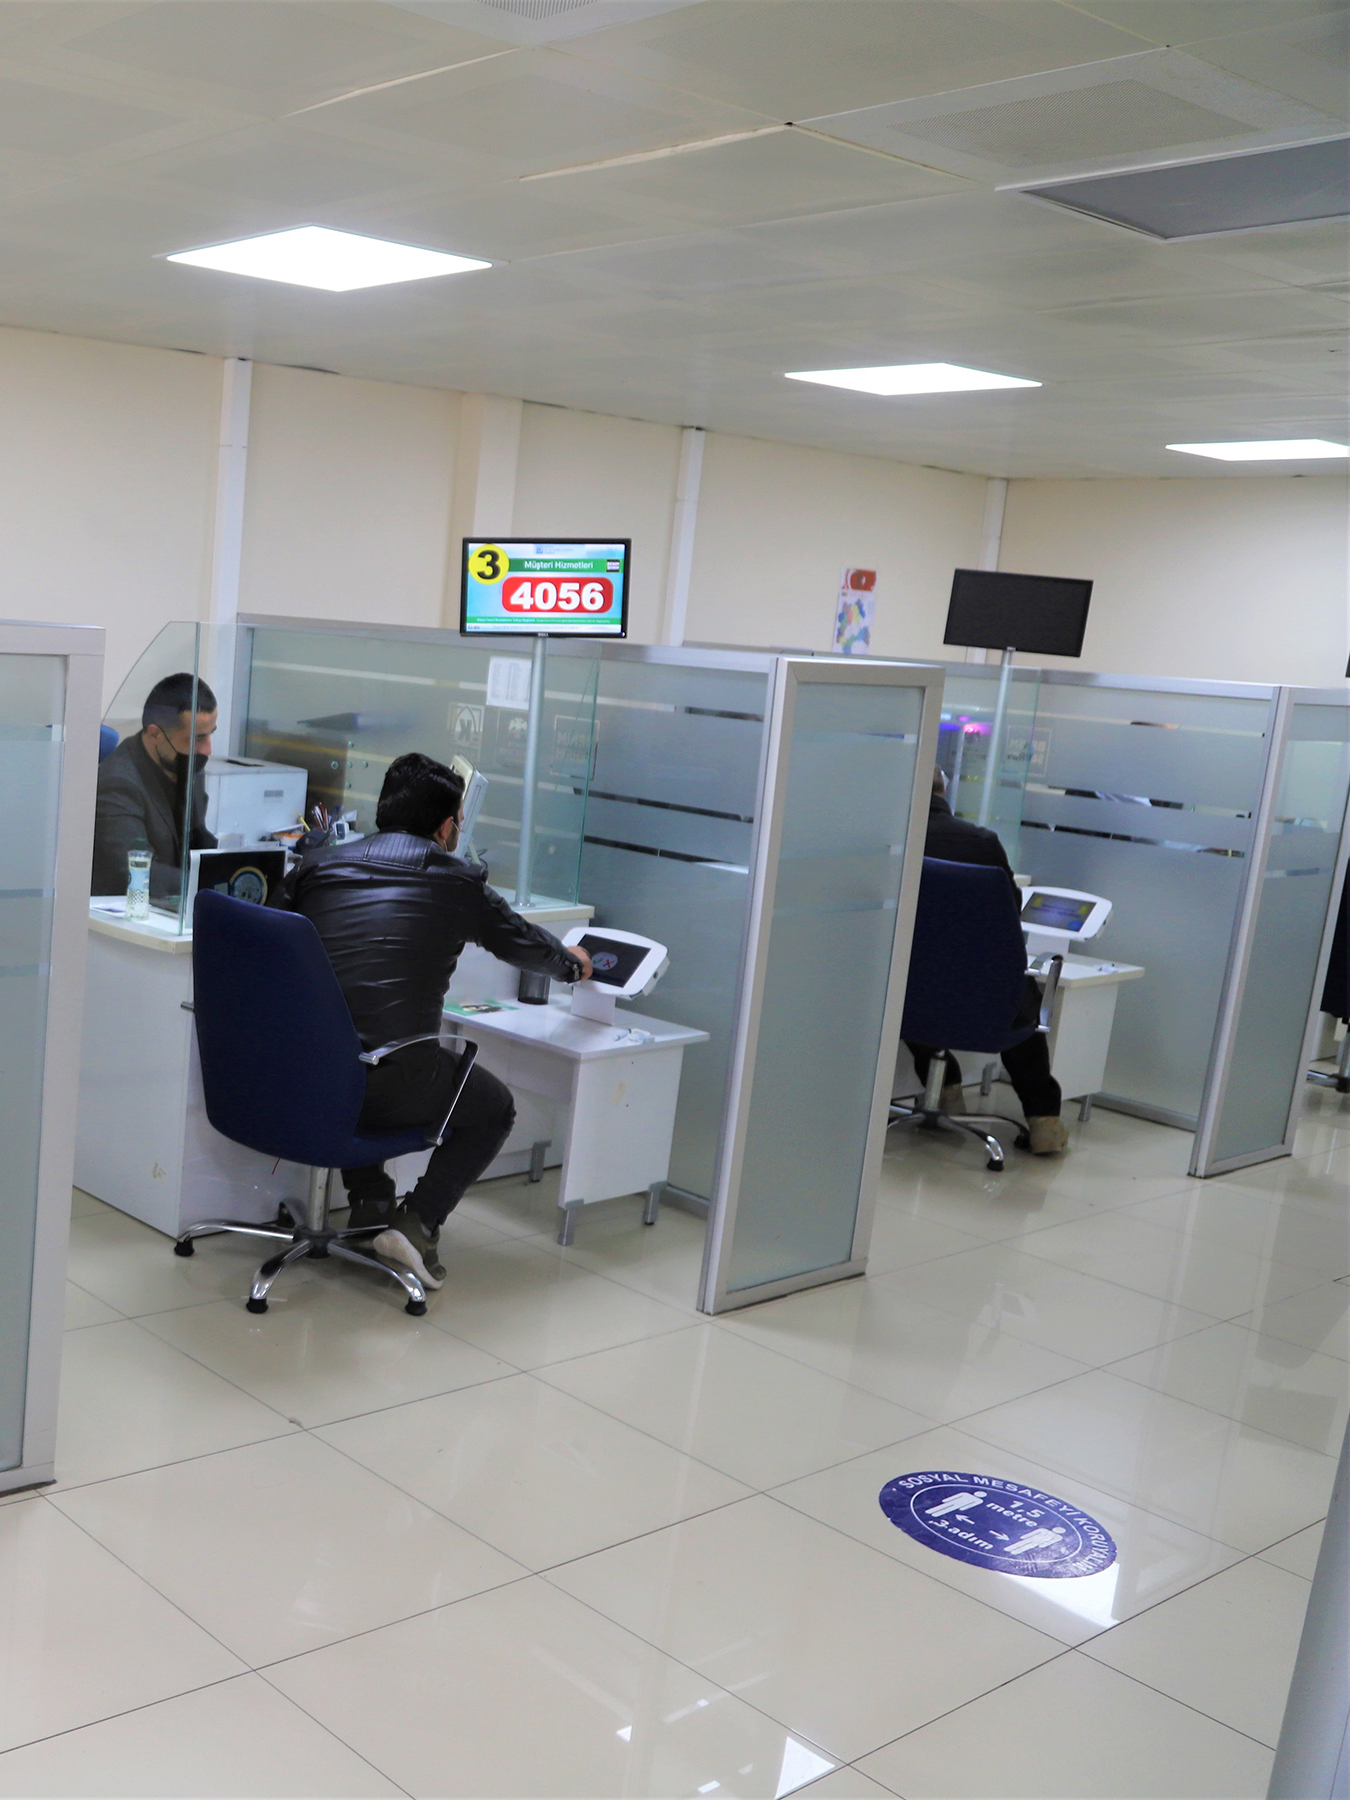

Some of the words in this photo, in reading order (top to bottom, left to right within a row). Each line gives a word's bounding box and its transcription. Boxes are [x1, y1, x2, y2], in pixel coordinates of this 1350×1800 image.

[477, 549, 501, 580] 3
[524, 560, 553, 570] Müşteri
[555, 561, 593, 569] Hizmetleri
[510, 581, 604, 611] 4056
[898, 1473, 969, 1489] SOSYAL
[986, 1502, 1038, 1528] metre
